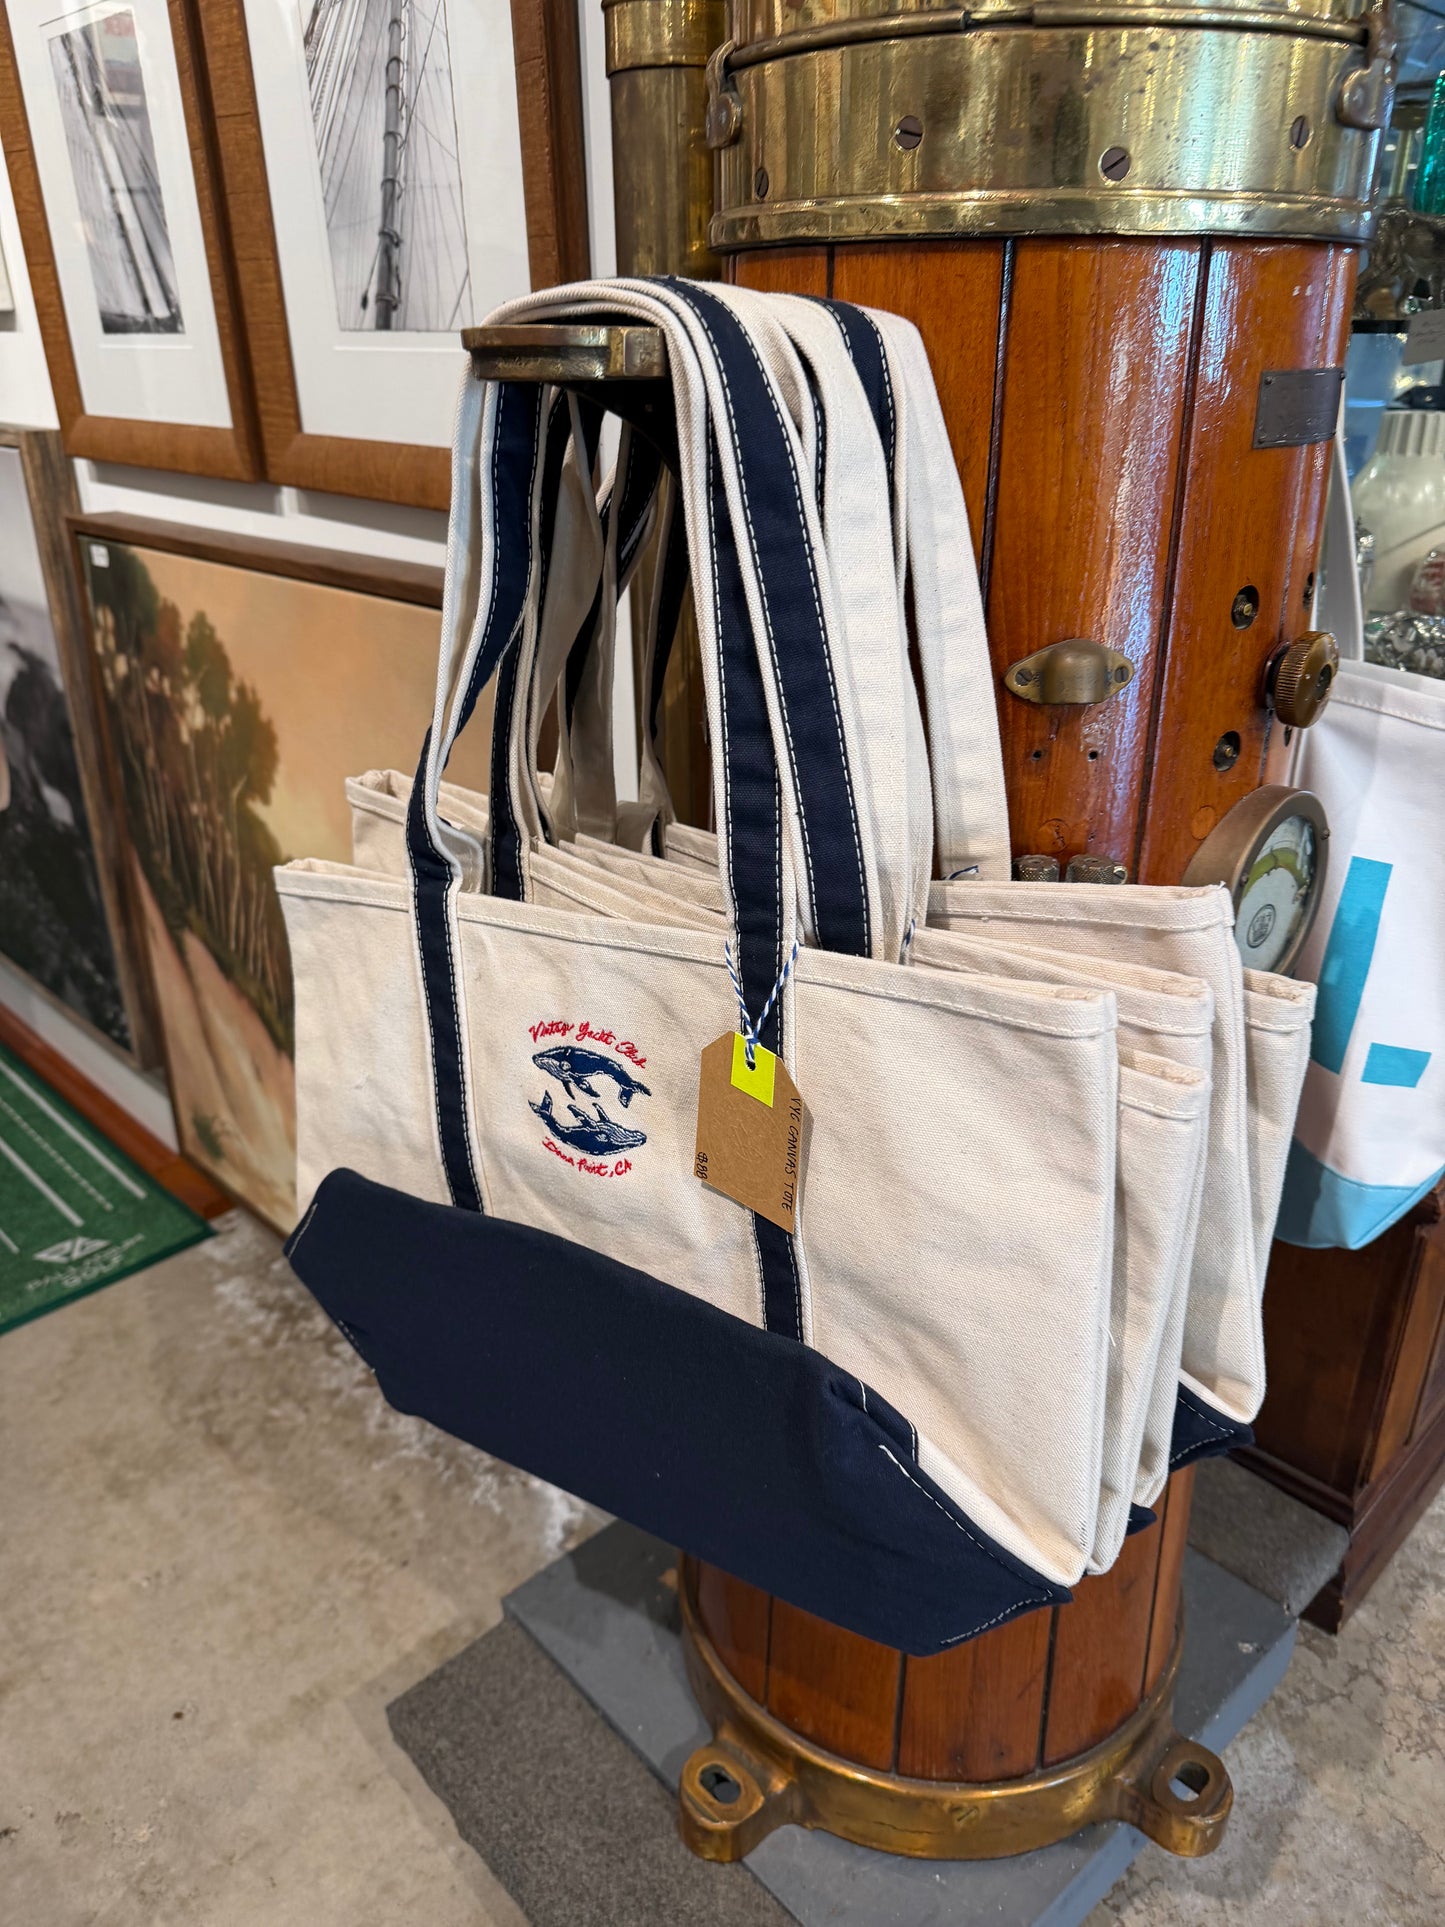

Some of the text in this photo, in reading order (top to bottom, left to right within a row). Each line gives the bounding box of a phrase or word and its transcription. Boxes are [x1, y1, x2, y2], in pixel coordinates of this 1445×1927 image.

[576, 1021, 617, 1045] Yacht
[615, 1041, 647, 1069] Club
[542, 1136, 575, 1167] Dana
[614, 1158, 633, 1176] CA
[695, 1151, 708, 1180] $88
[785, 1125, 799, 1178] CANVAS
[781, 1182, 795, 1216] TOTE
